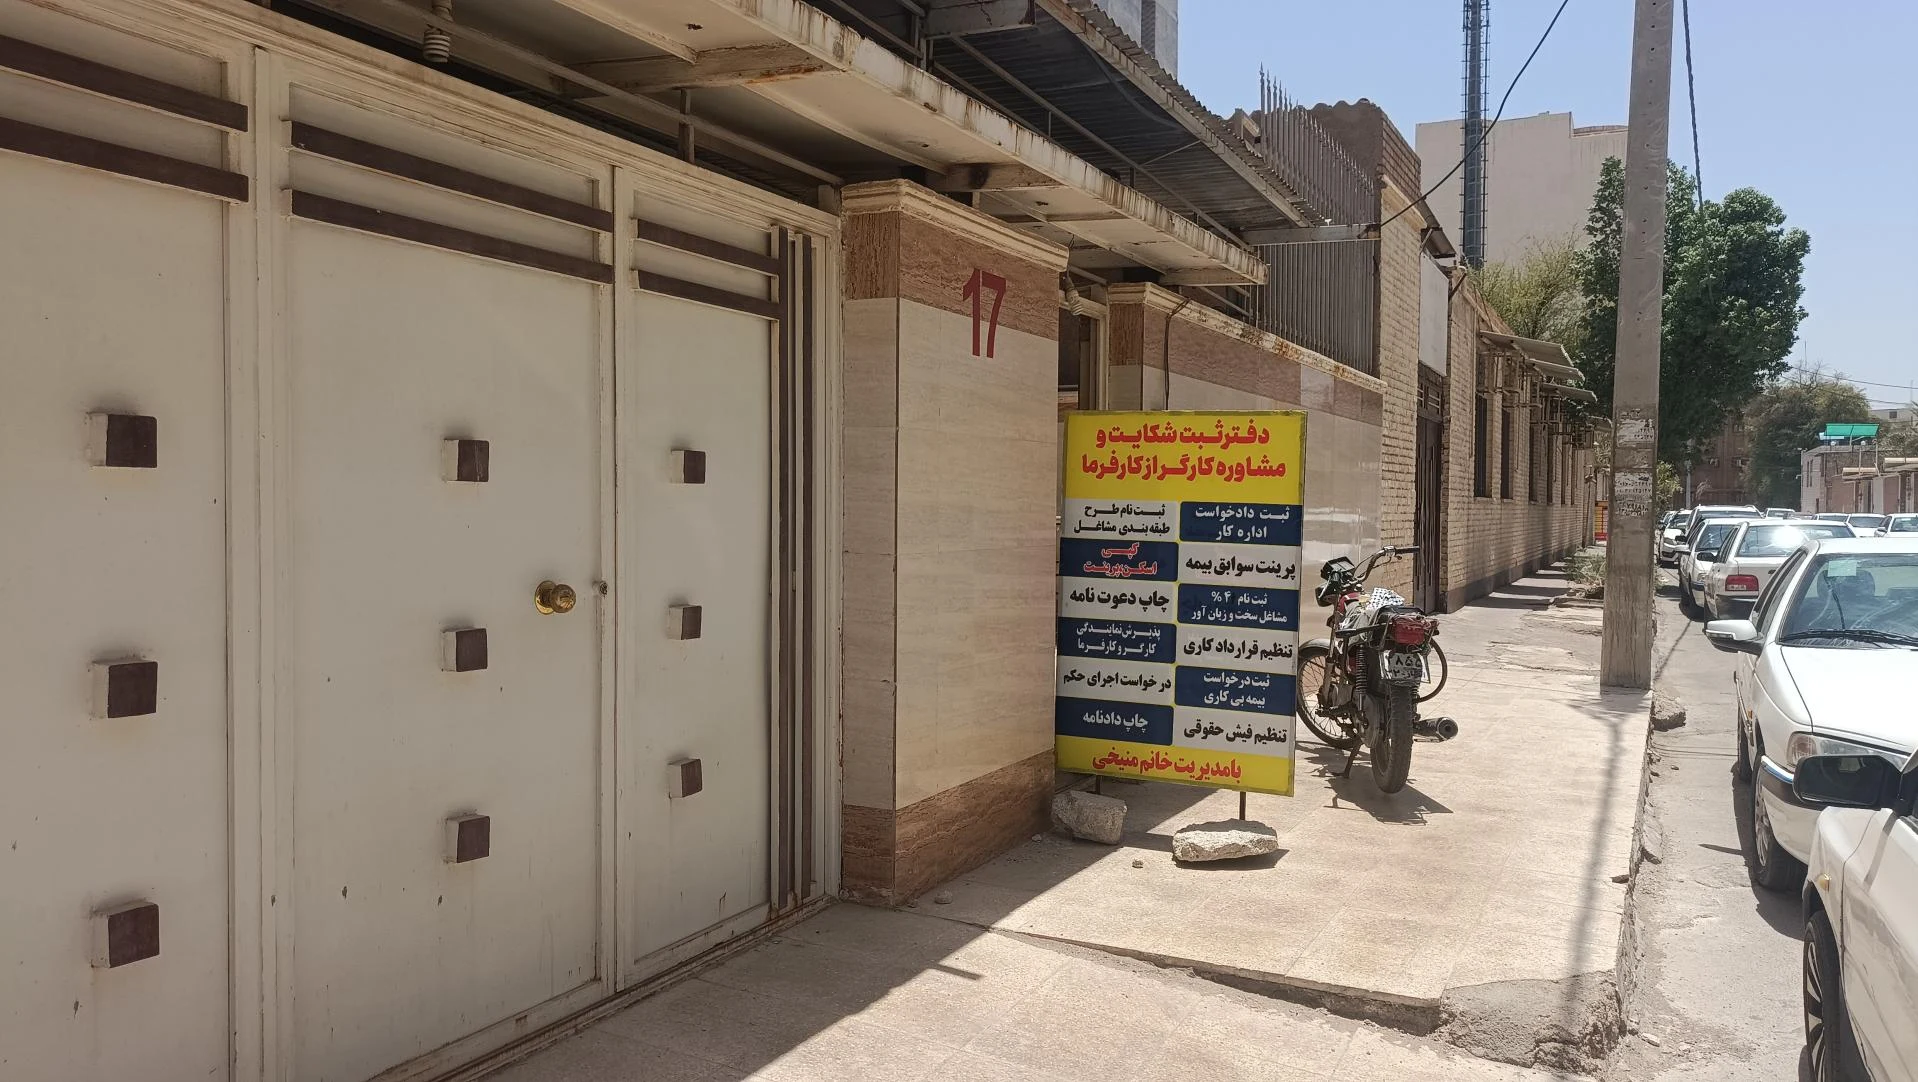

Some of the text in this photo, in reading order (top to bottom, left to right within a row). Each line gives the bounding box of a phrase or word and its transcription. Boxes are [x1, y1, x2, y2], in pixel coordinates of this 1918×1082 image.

[963, 268, 1006, 358] 17
[1096, 418, 1270, 450] دفتر ثبت شکایت و
[1082, 449, 1286, 482] مشاوره کارگر از کارفرما
[1084, 503, 1165, 519] ثبت نام طرح
[1195, 505, 1290, 523] ثبت دادخواست
[1073, 520, 1170, 536] طبقه بندی مشاغل
[1215, 524, 1267, 541] اداره کار
[1101, 542, 1140, 559] کپی
[1185, 556, 1296, 581] پرینت سوابق بیمه
[1069, 587, 1170, 613] چاپ دعوت نامه
[1237, 593, 1251, 605] نام
[1251, 593, 1269, 607] ثبت
[1191, 605, 1288, 624] مشاغل سخت و زیان آور
[1121, 624, 1161, 640] پذیرش
[1077, 638, 1157, 656] کارگر و کارفرما
[1183, 637, 1214, 655] کاری
[1259, 642, 1293, 660] تنظیم
[1063, 669, 1086, 684] حکم
[1087, 670, 1119, 688] اجرای
[1251, 674, 1271, 690] ثبت
[1245, 693, 1266, 708] بیمه
[1123, 713, 1148, 733] چاپ
[1183, 718, 1287, 744] تنظیم فیش حقوقی
[1139, 750, 1173, 774] خانم
